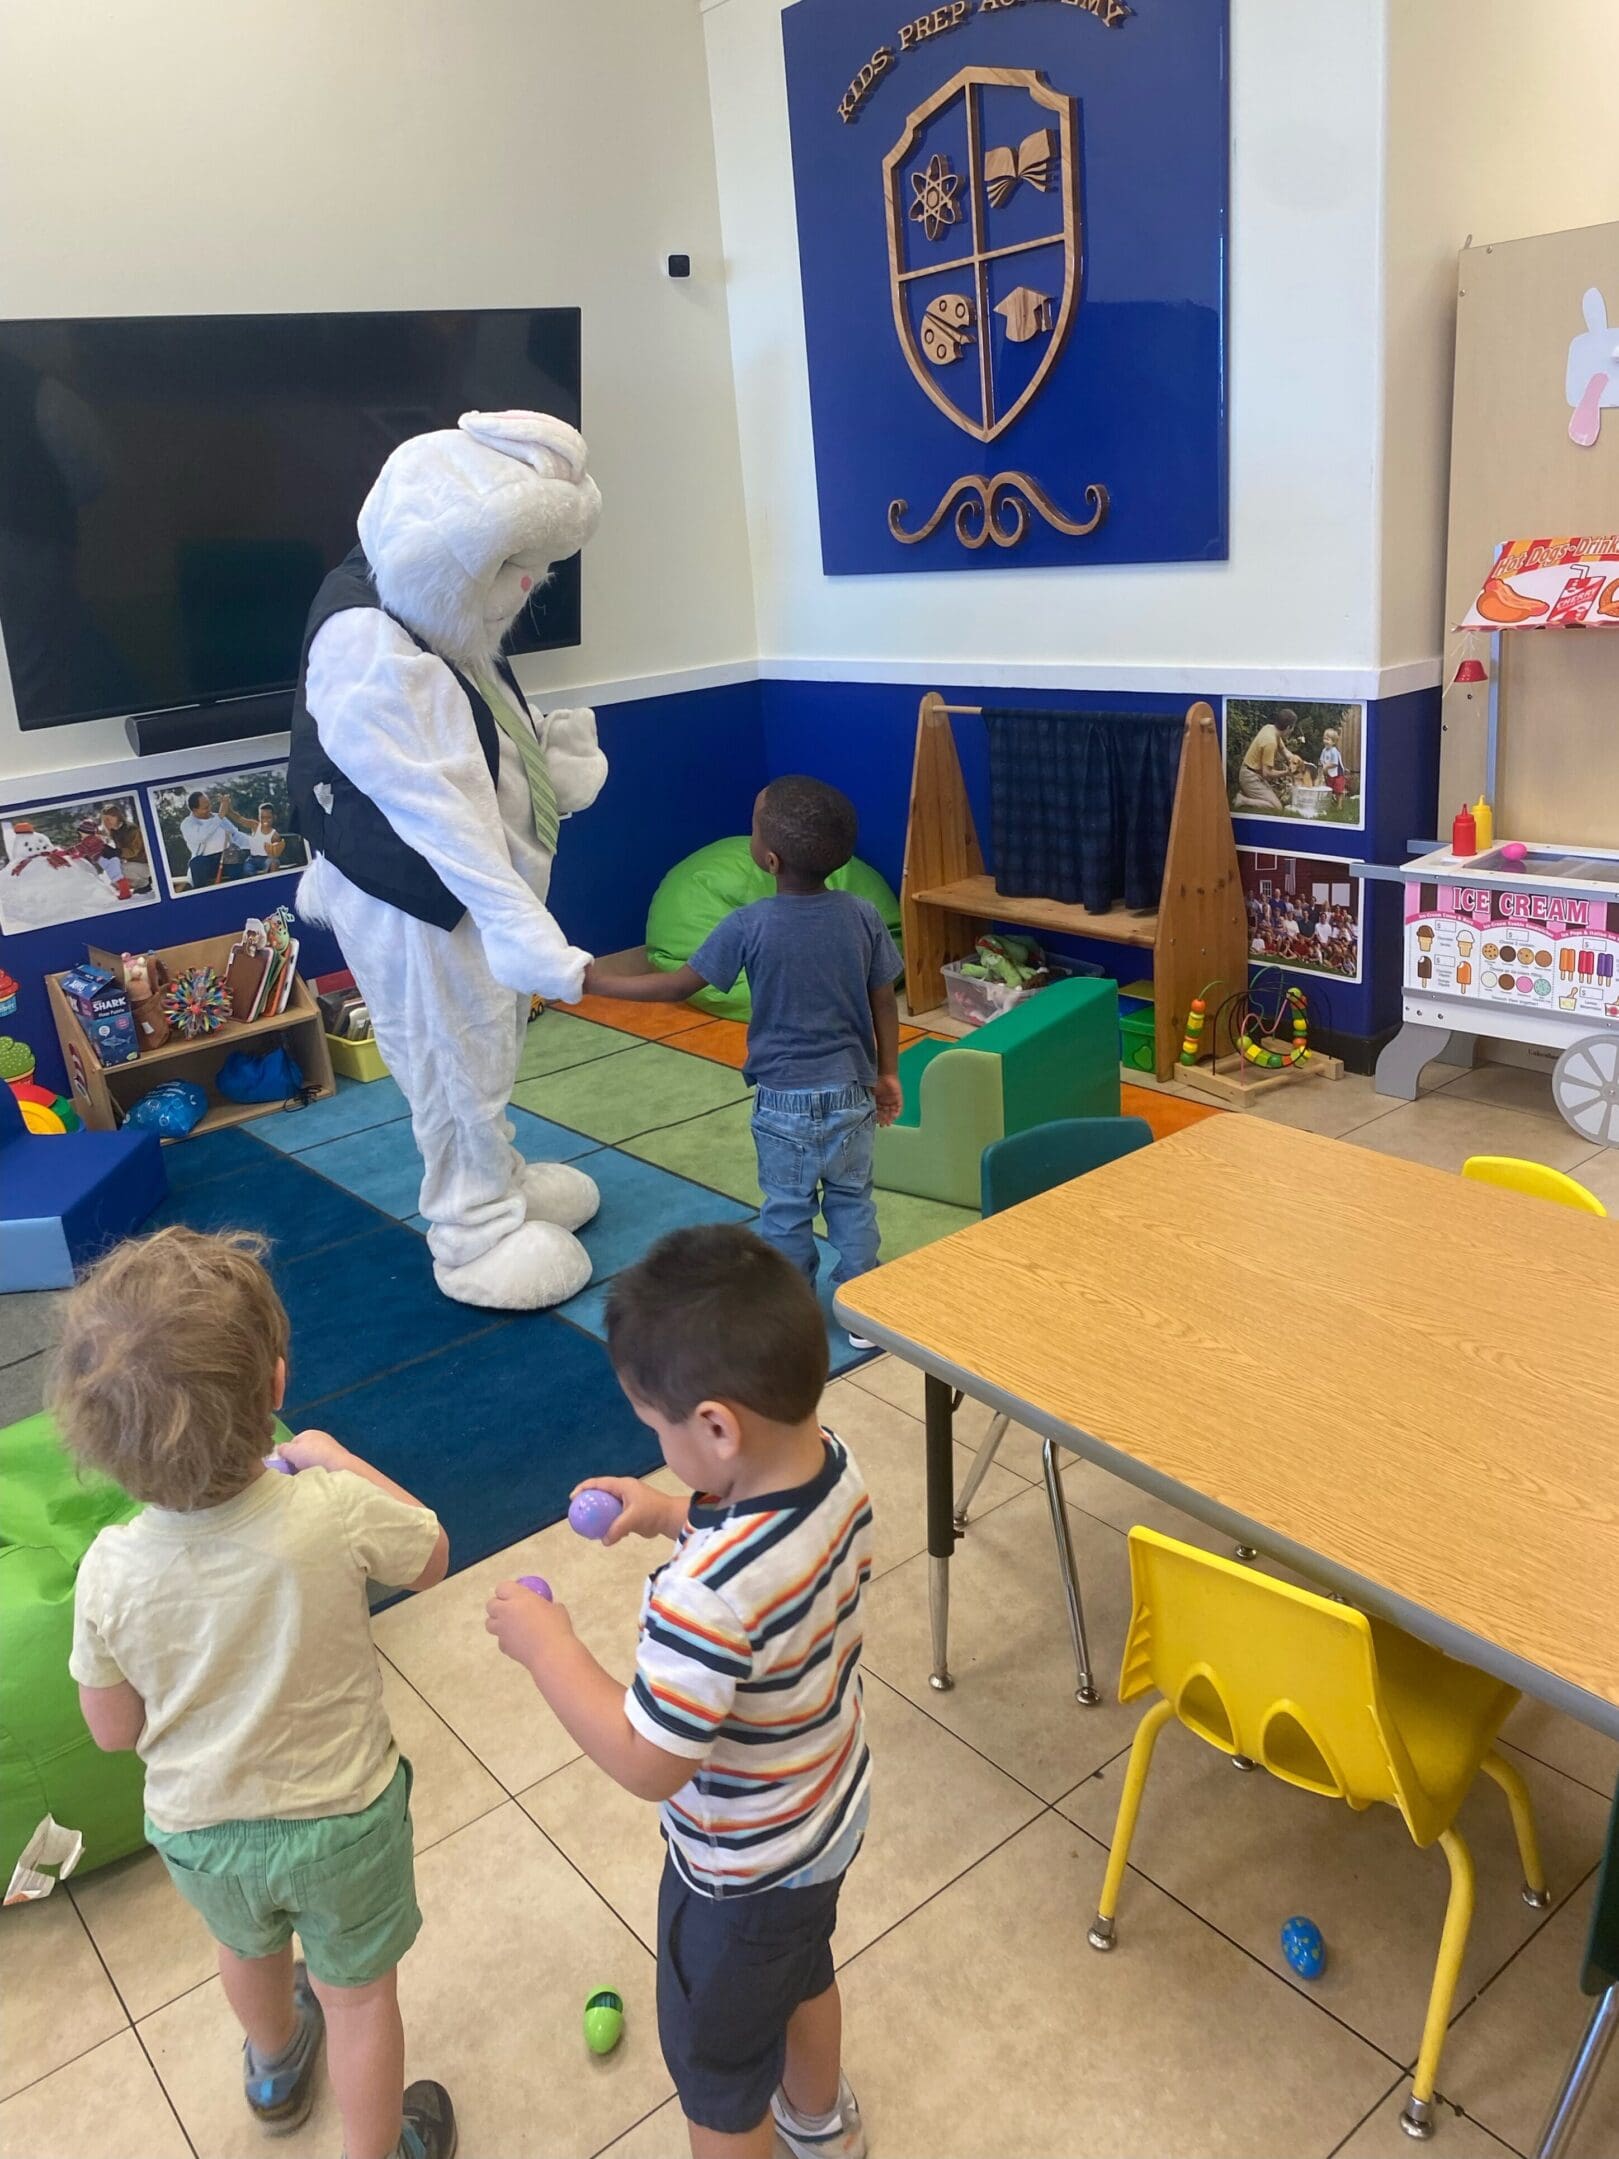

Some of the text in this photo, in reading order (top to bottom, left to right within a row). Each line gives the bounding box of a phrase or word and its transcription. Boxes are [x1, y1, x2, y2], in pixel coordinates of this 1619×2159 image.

[837, 46, 890, 123] KIDS
[897, 1, 966, 51] PREP
[1491, 551, 1528, 579] Hot
[1525, 544, 1568, 568] Dogs
[1452, 887, 1589, 926] ICE CREAM
[93, 996, 127, 1012] SHARK
